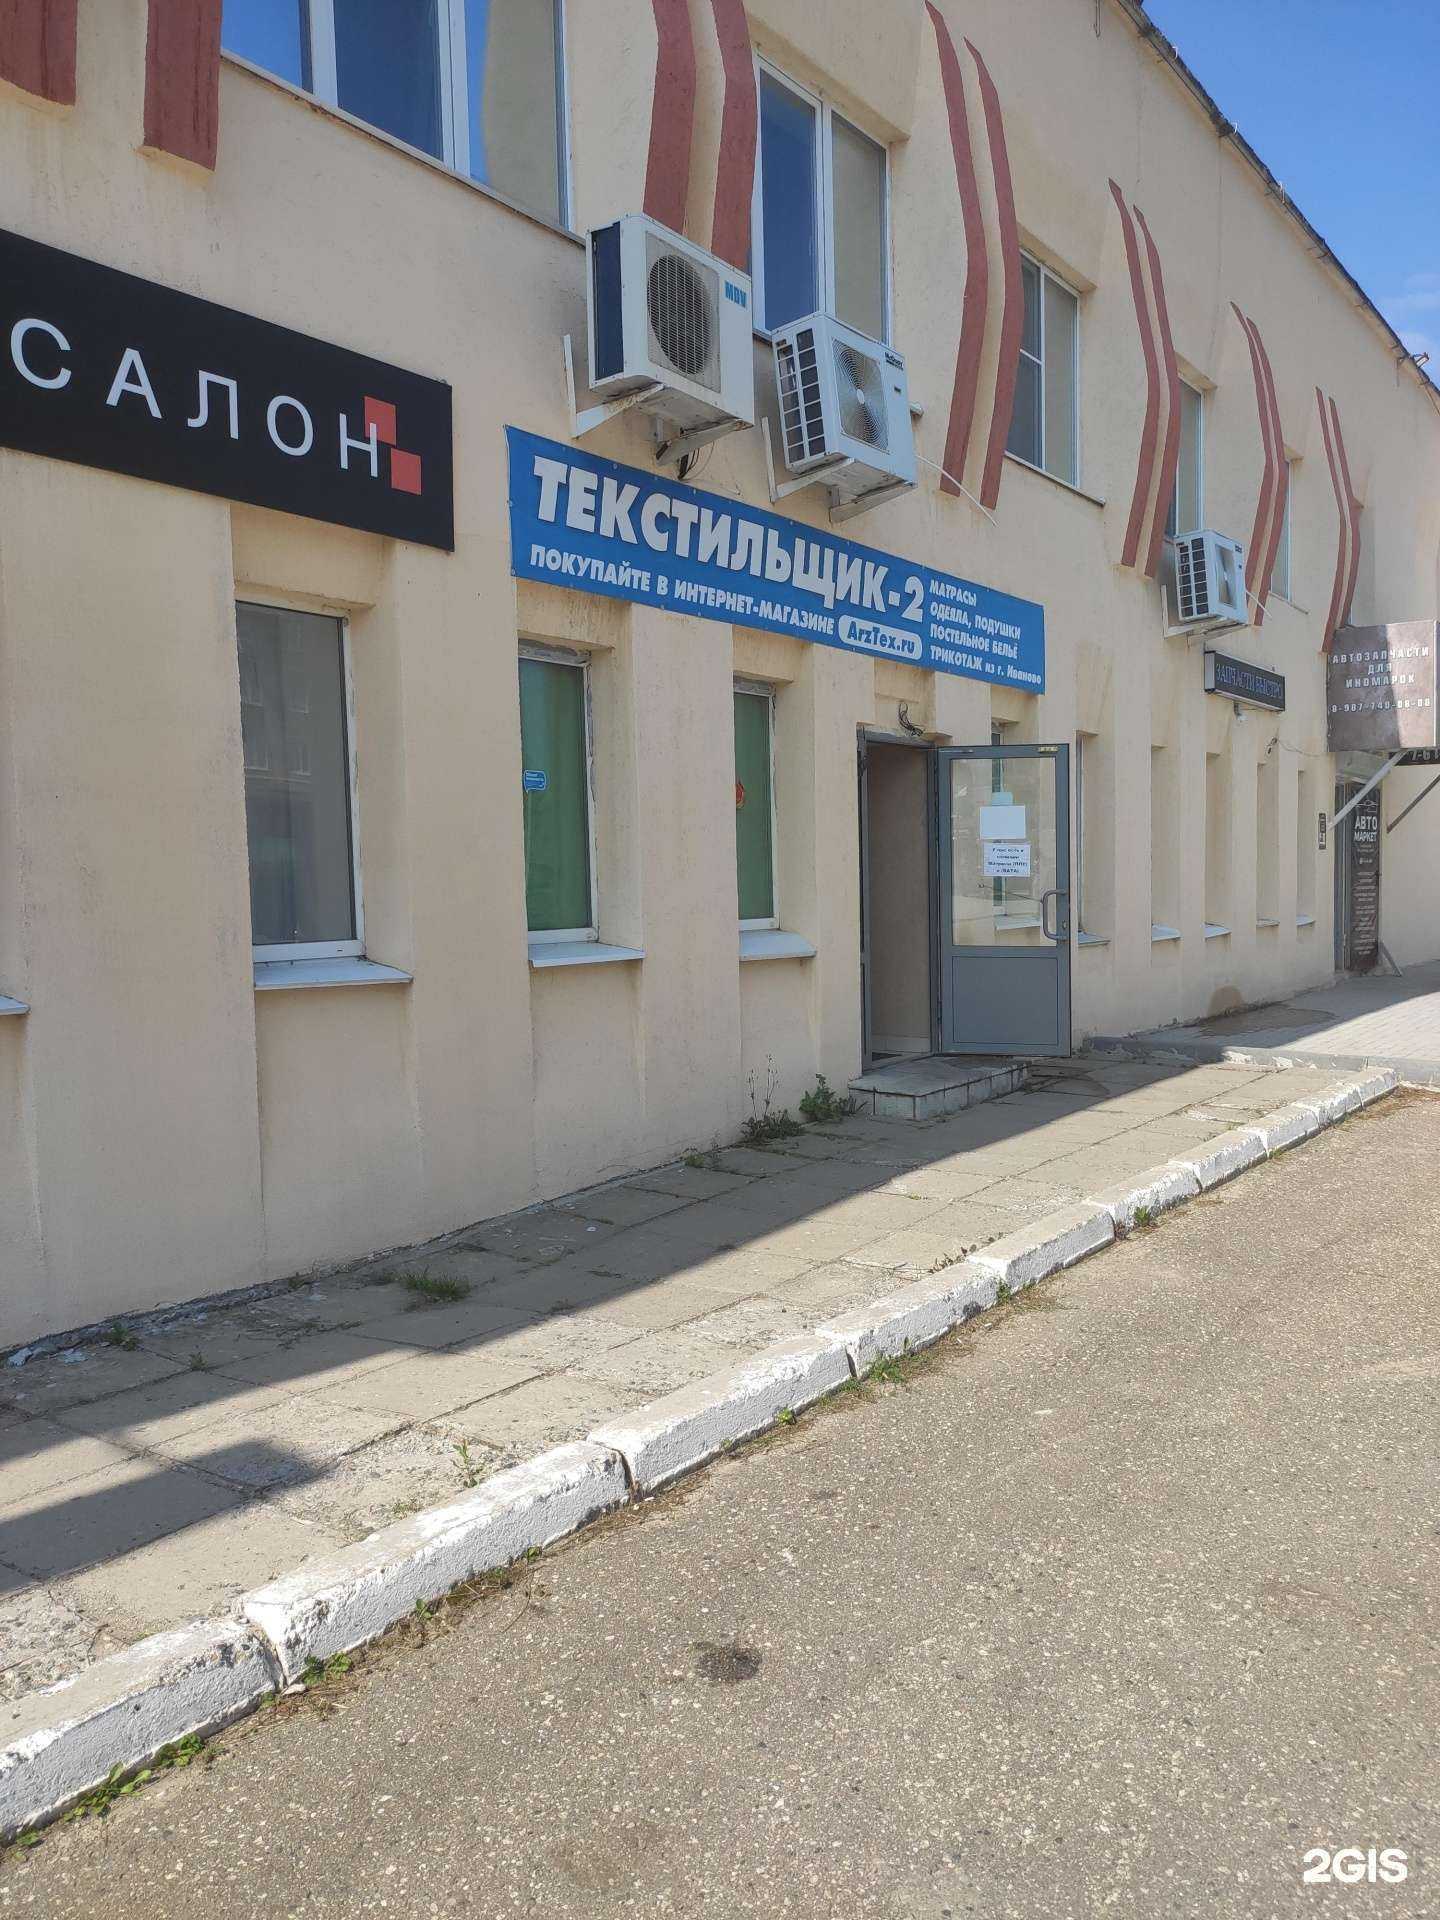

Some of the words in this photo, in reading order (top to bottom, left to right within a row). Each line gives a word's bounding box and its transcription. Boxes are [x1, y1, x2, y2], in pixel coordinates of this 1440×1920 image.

[10, 318, 378, 478] САЛОН
[533, 455, 924, 623] ТЕКСТИЛЬЩИК-2
[530, 543, 651, 593] ПОКУПАЙТЕ
[656, 574, 669, 596] В
[673, 580, 835, 636] ИНТЕРНЕТ-МАГАЗИНЕ
[929, 579, 977, 607] МАТРАСЫ
[846, 619, 916, 655] ArzTex.ru
[930, 601, 972, 628] ОДЕЯЛА,
[974, 614, 1021, 640] ПОДУШКИ
[930, 623, 990, 652] ПОСТЕЛЬНОЕ
[992, 640, 1018, 660] БЕЛЬЁ
[1332, 647, 1430, 664] АВТОЗАПЧАСТИ
[930, 645, 983, 671] ТРИКОТАЖ
[985, 662, 995, 674] из
[997, 665, 1004, 676] г.
[1006, 664, 1042, 685] Иваново
[1345, 674, 1415, 688] ИНОМАРОК
[1367, 663, 1393, 675] ДЛЯ
[1354, 815, 1378, 830] АВТО
[1354, 831, 1378, 842] МАРКЕТ
